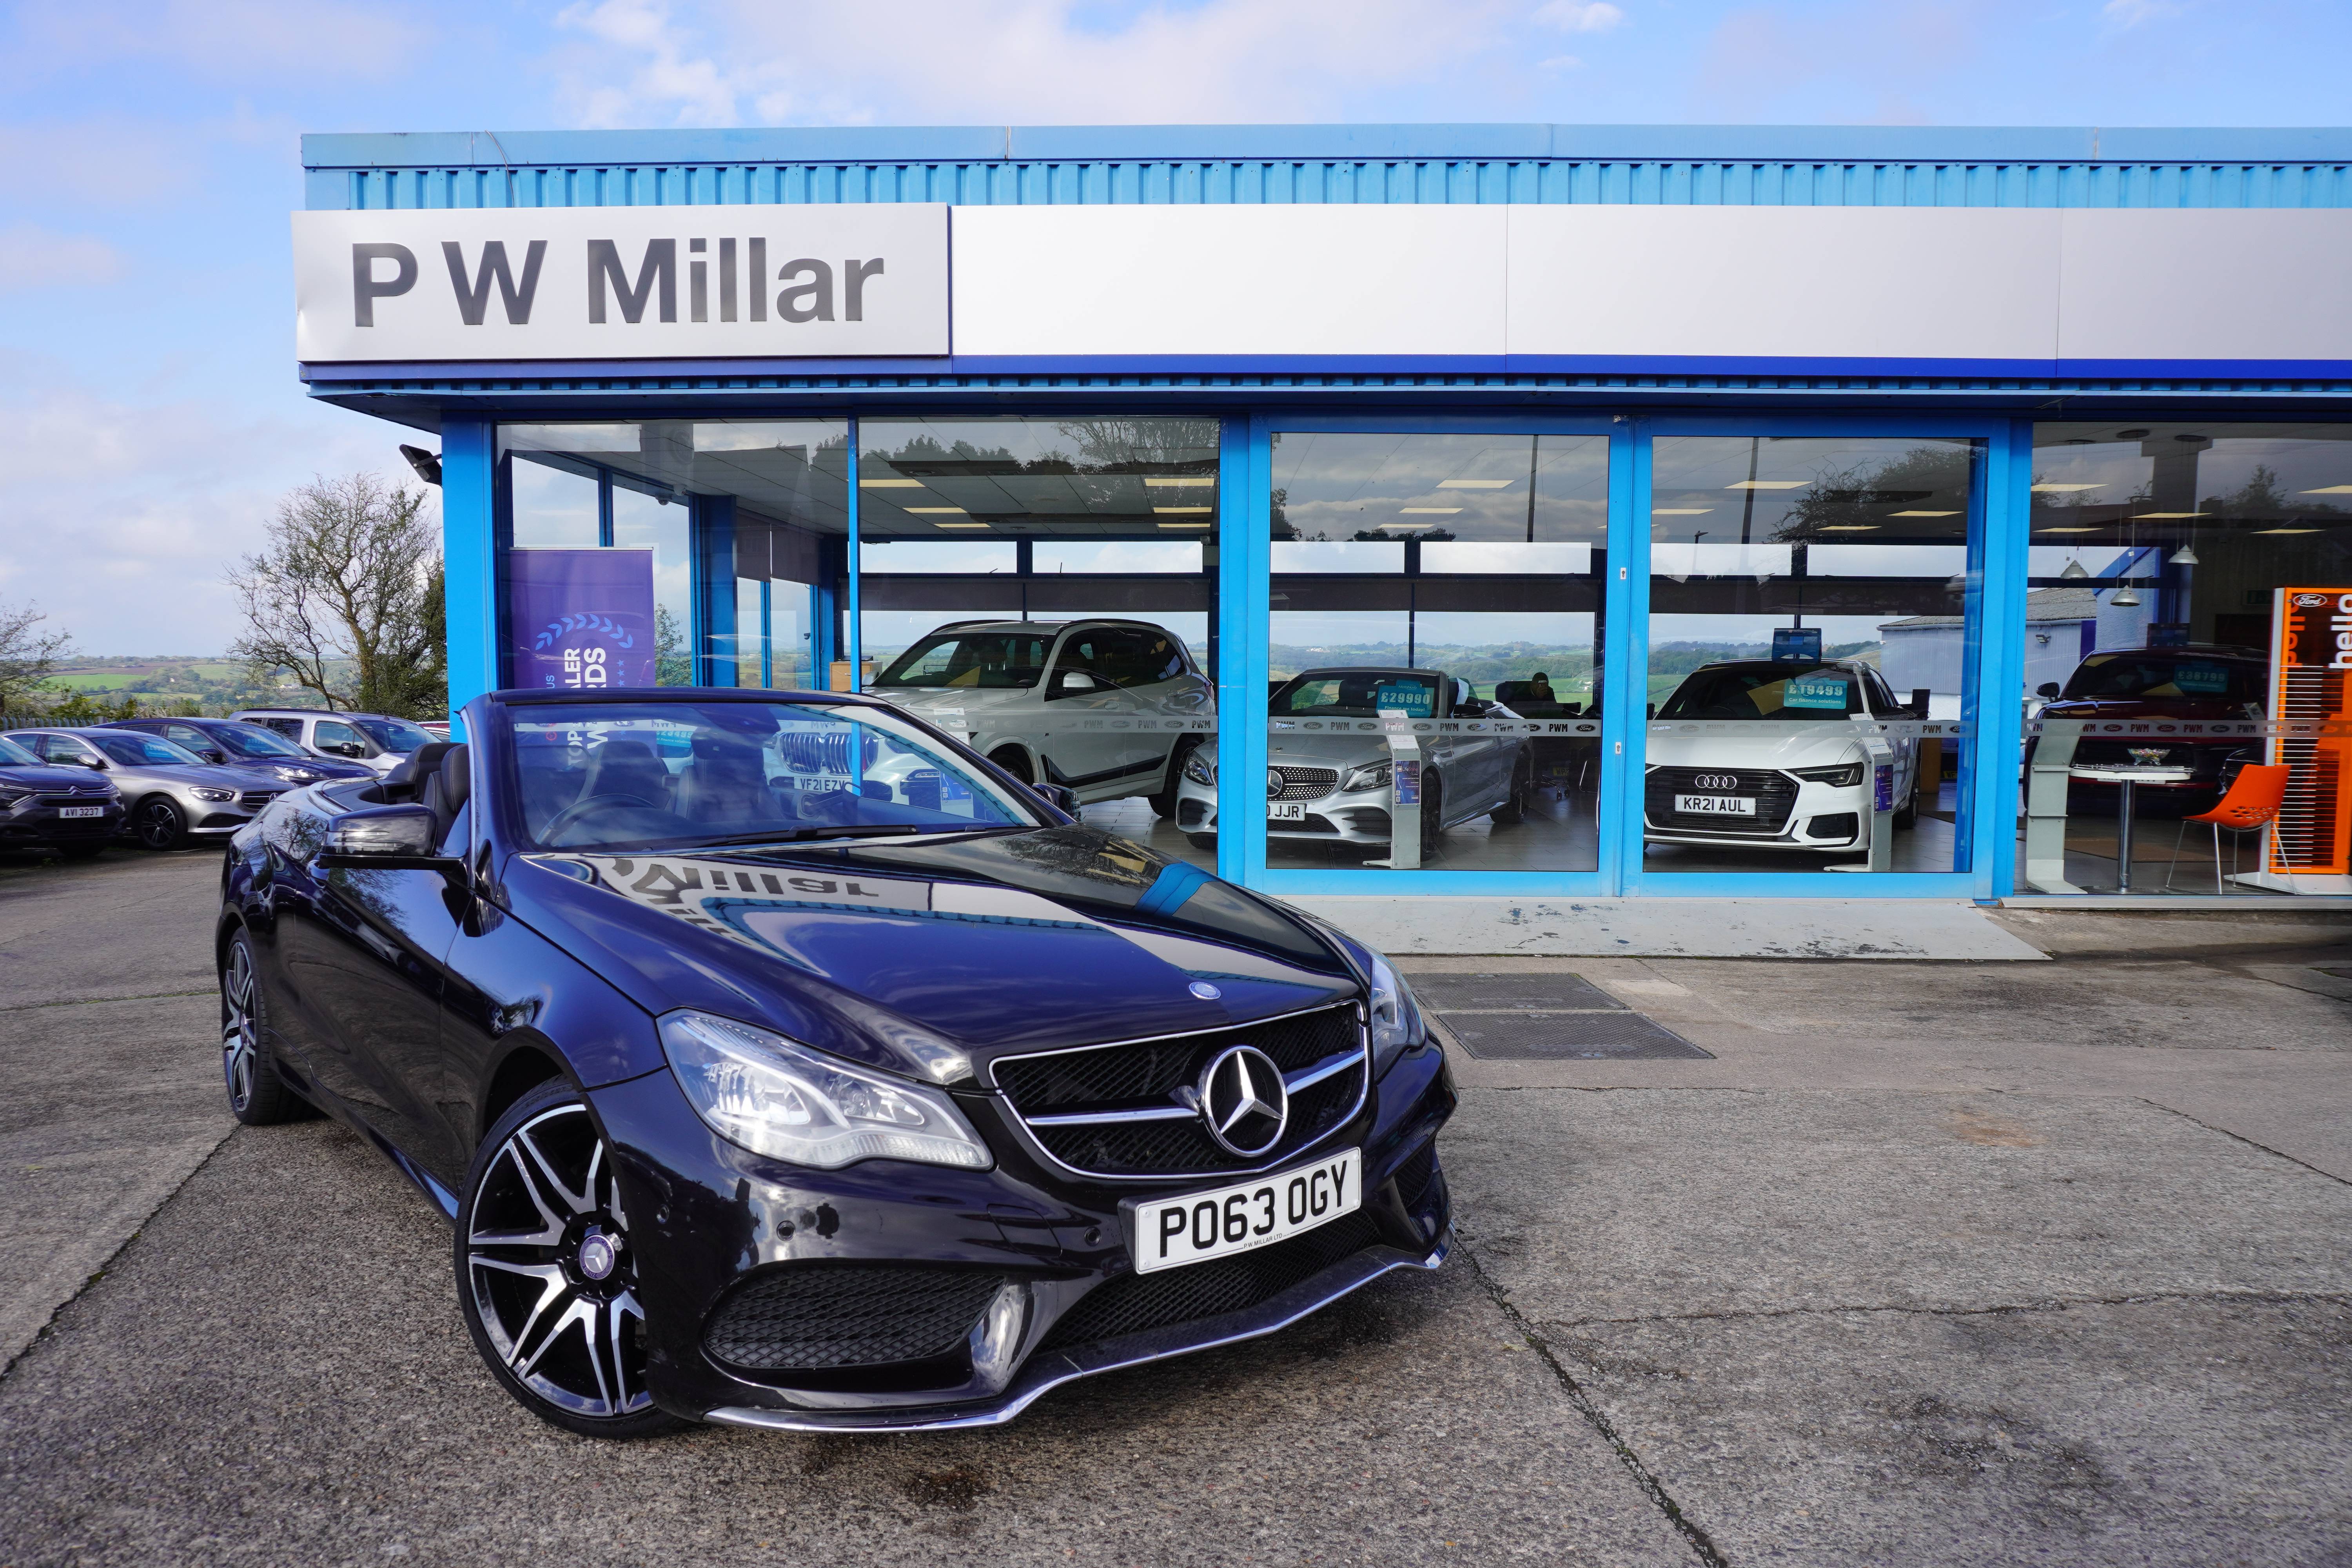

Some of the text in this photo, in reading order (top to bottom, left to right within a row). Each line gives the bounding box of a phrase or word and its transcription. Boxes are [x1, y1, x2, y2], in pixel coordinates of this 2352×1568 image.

[352, 237, 884, 327] P W Millar
[2298, 595, 2322, 605] Ford
[1788, 684, 1843, 696] £19499
[1381, 692, 1430, 704] £29990
[1138, 720, 1157, 729] PWM
[1192, 720, 1210, 729] PWM
[1276, 721, 1295, 730] PWM
[1331, 722, 1350, 730] PWM
[1385, 722, 1404, 731] PWM
[1440, 723, 1459, 731] PWM
[1494, 723, 1514, 732] PWM
[1549, 724, 1568, 732] PWM
[1922, 725, 1942, 733] PWM
[2131, 724, 2149, 732] PWM
[2183, 724, 2203, 733] PWM
[2238, 724, 2256, 733] PWM
[800, 778, 822, 791] VF21
[1684, 797, 1746, 812] KR21 AUL
[79, 808, 98, 816] 3237
[1274, 805, 1299, 818] JJR
[1159, 1160, 1348, 1259] PO63 OGY
